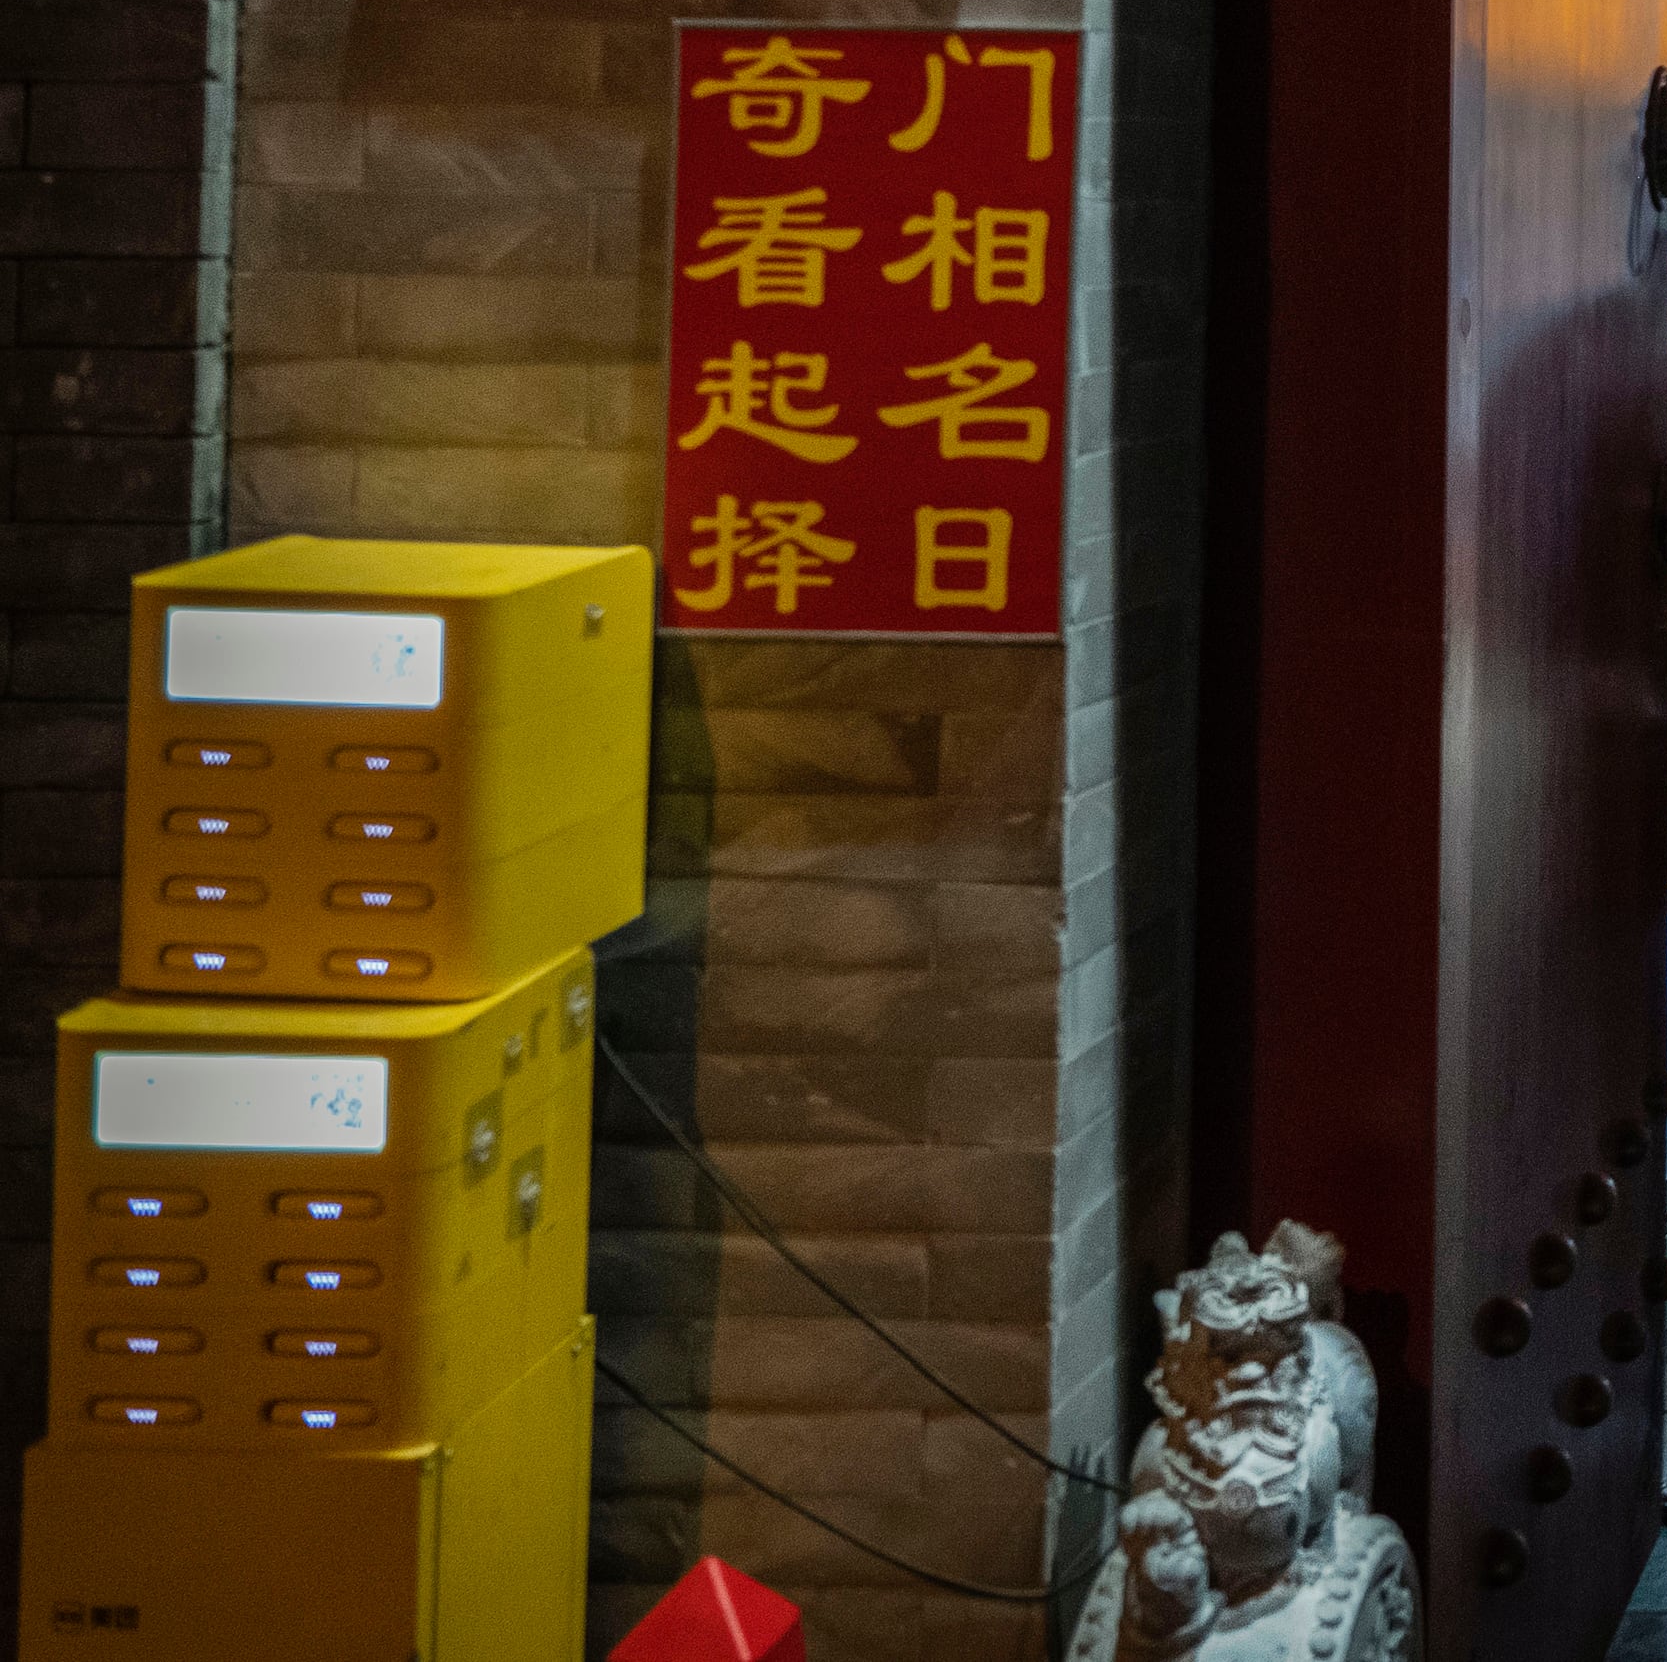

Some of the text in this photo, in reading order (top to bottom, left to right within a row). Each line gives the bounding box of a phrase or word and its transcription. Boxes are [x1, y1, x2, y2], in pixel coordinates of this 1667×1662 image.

[692, 37, 1056, 161] 奇门
[684, 188, 1050, 312] 看相
[677, 340, 1050, 464] 起名
[675, 494, 1014, 615] 择日
